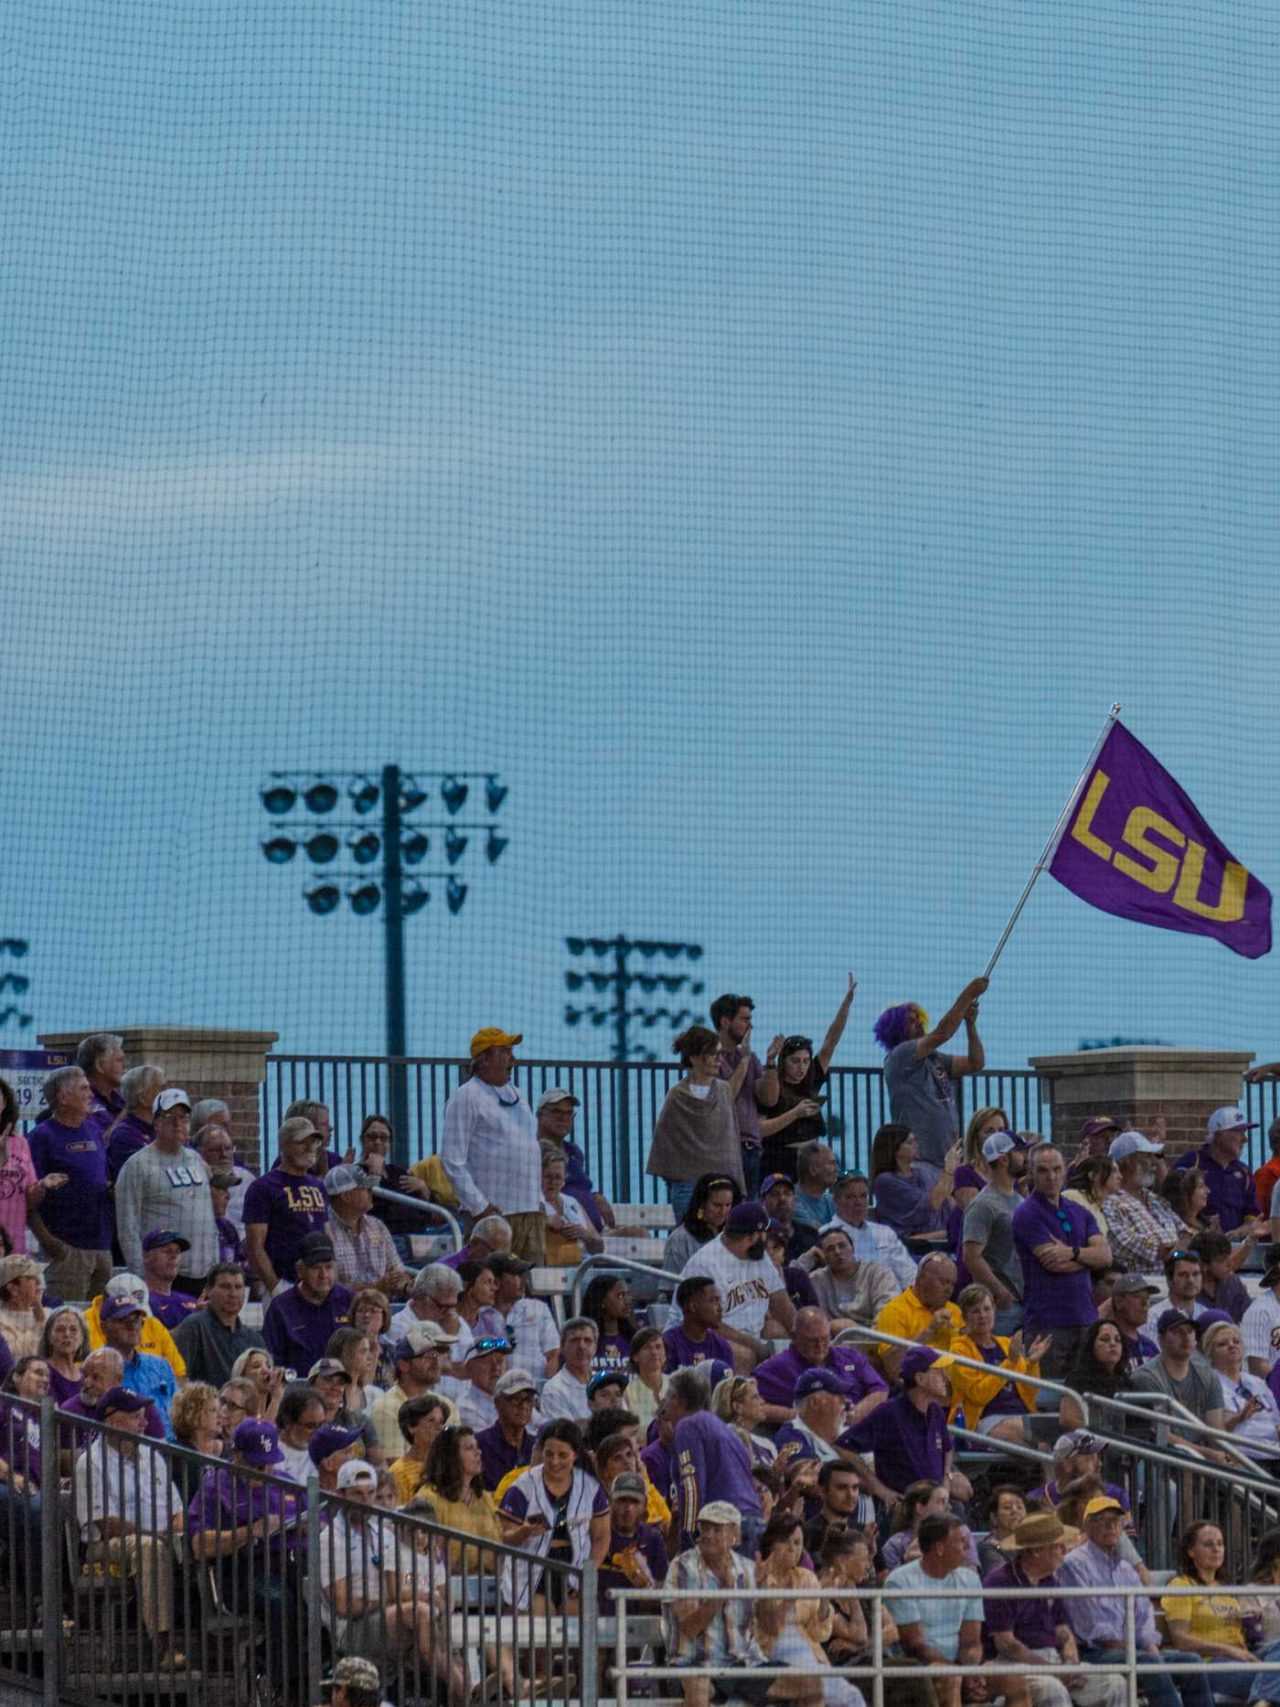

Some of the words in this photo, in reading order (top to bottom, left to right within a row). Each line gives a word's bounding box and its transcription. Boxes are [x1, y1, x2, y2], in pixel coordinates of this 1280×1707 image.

[1071, 769, 1249, 923] LSU
[166, 1168, 203, 1187] LSU
[283, 1185, 325, 1209] LSU
